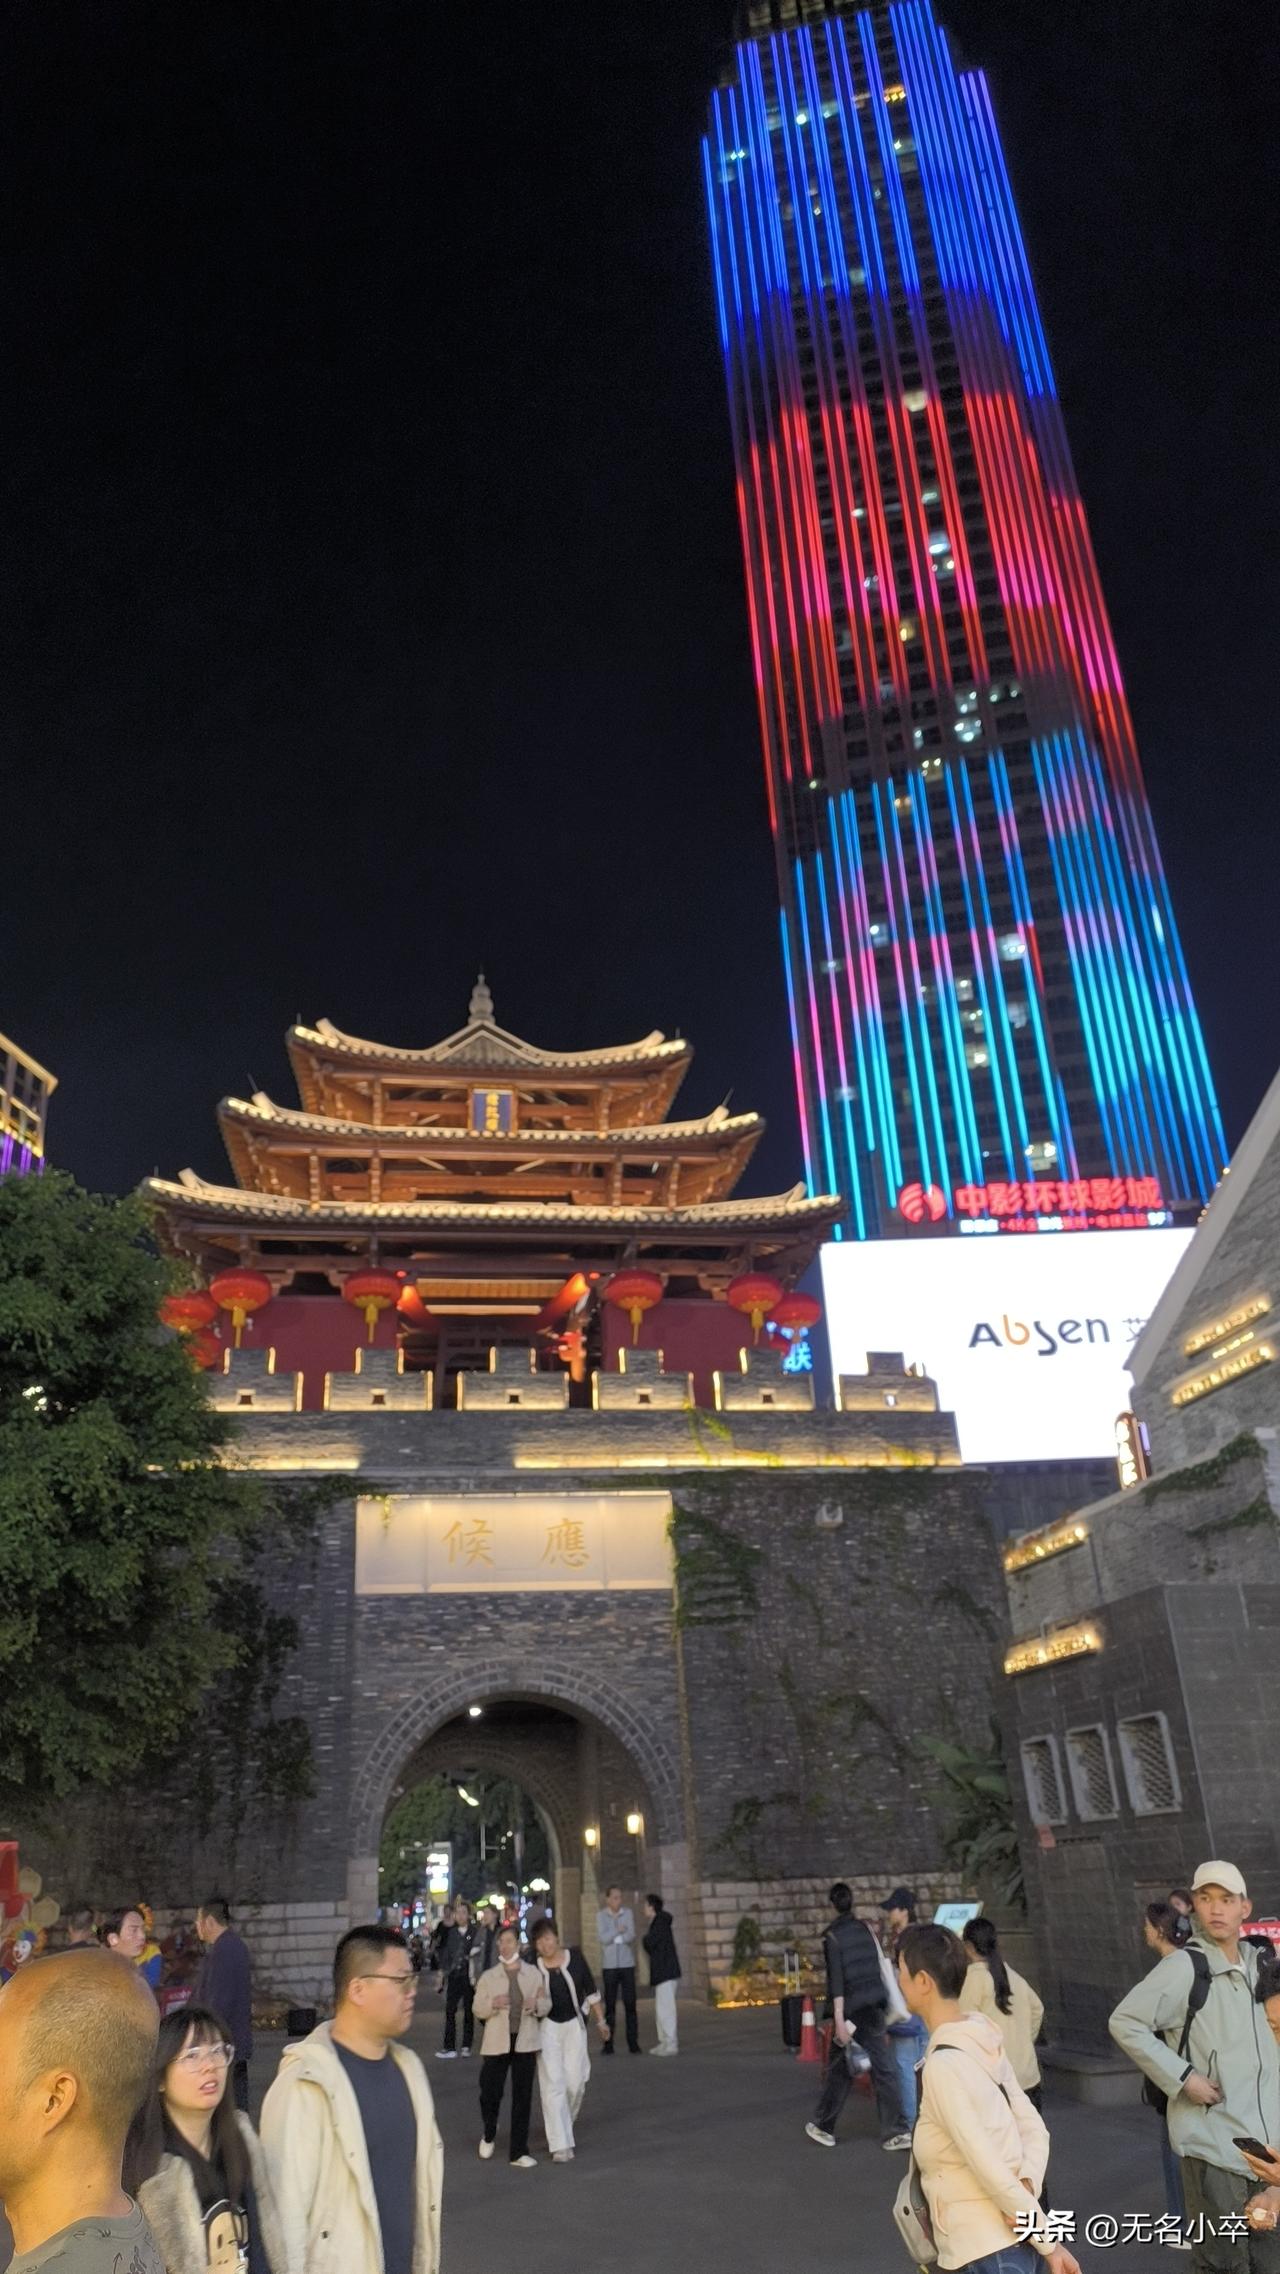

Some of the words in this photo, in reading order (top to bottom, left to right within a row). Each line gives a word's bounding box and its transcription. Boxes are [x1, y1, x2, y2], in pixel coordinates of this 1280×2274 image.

[955, 1177, 1164, 1217] 中影环球影城
[968, 1314, 1111, 1356] Absen
